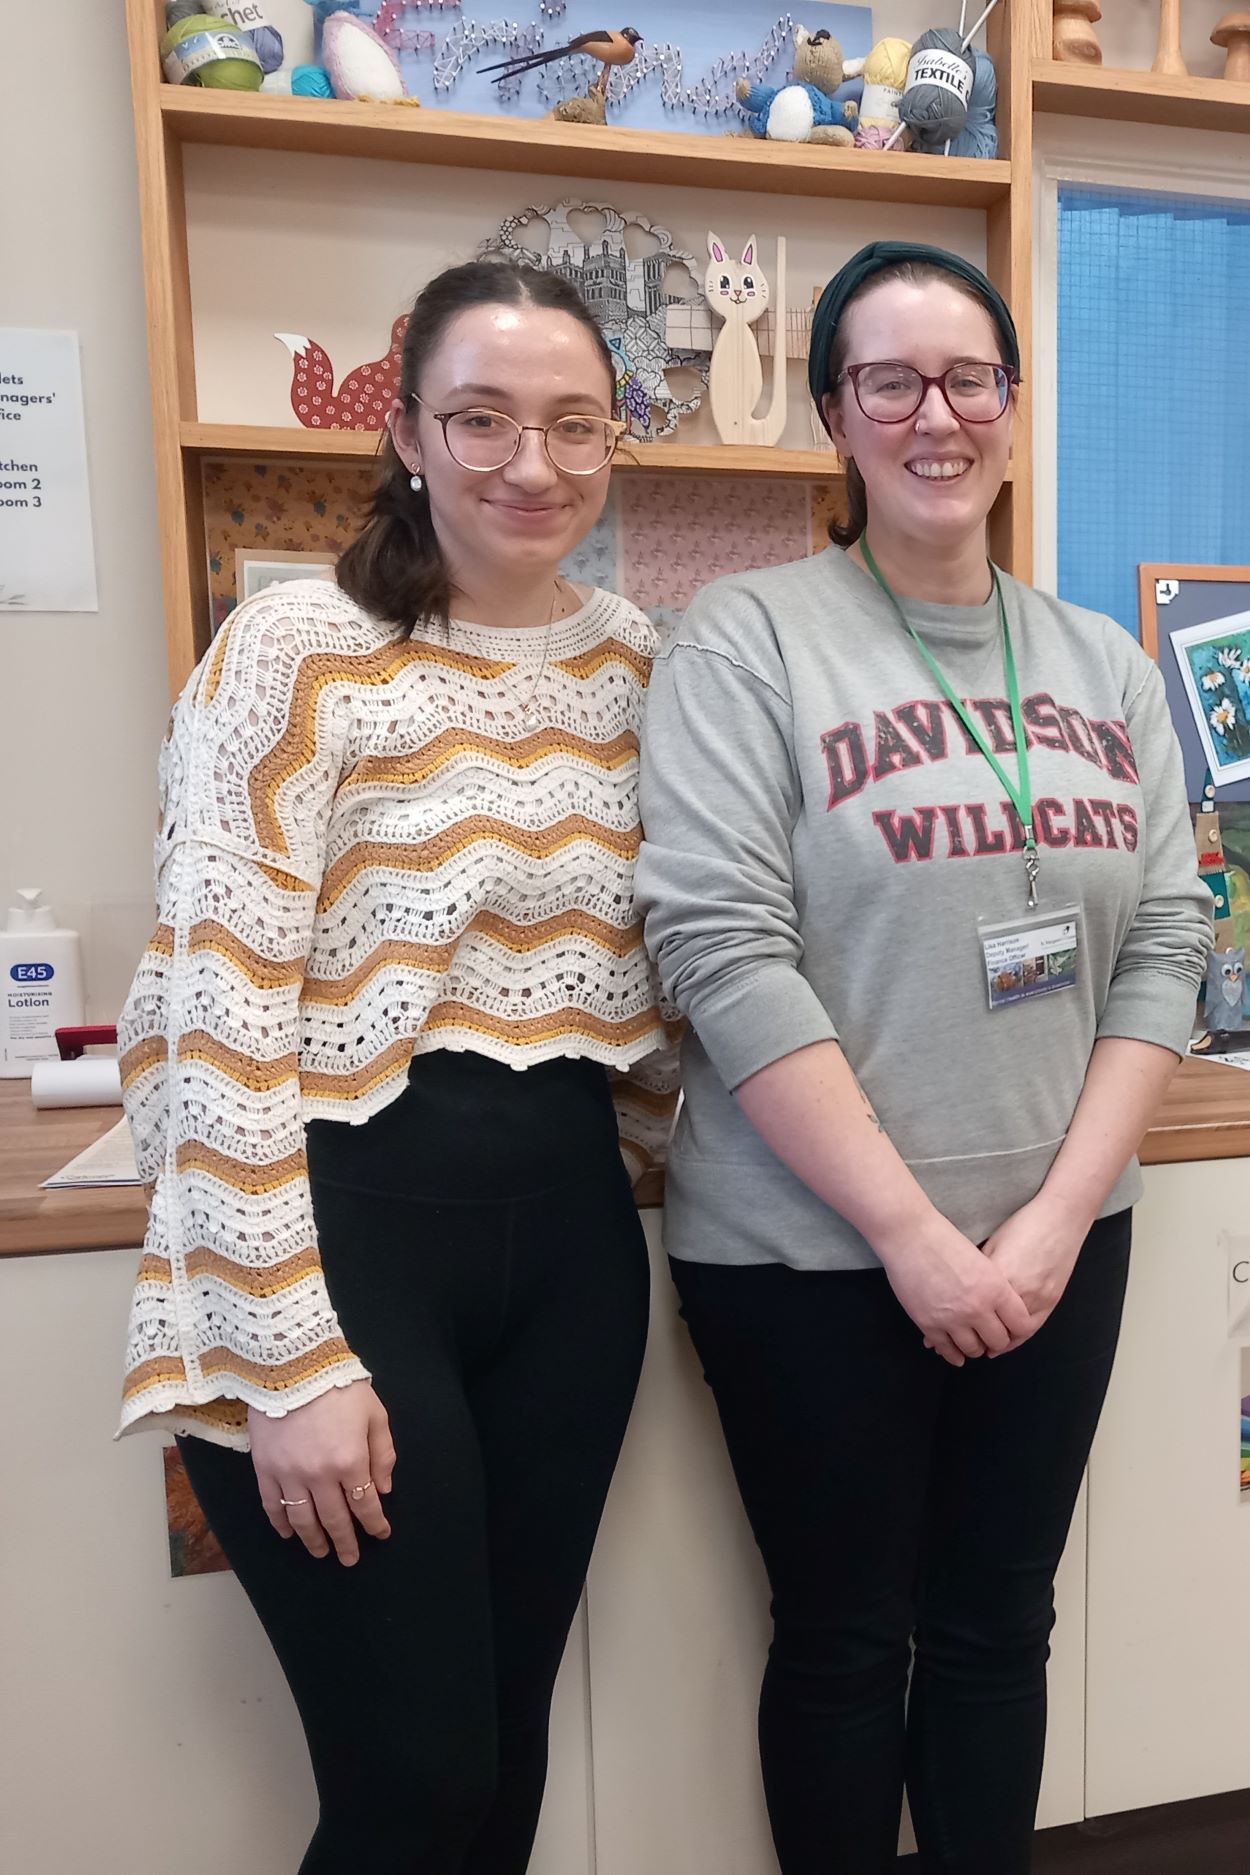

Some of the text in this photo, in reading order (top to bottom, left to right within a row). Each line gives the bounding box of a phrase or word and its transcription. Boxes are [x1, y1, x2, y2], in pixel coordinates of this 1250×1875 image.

[914, 67, 965, 94] TEXTILE
[31, 478, 42, 490] 2
[32, 496, 42, 508] 3
[820, 692, 1140, 812] DAVIDSON
[17, 966, 47, 979] E45
[8, 997, 50, 1008] Lotion
